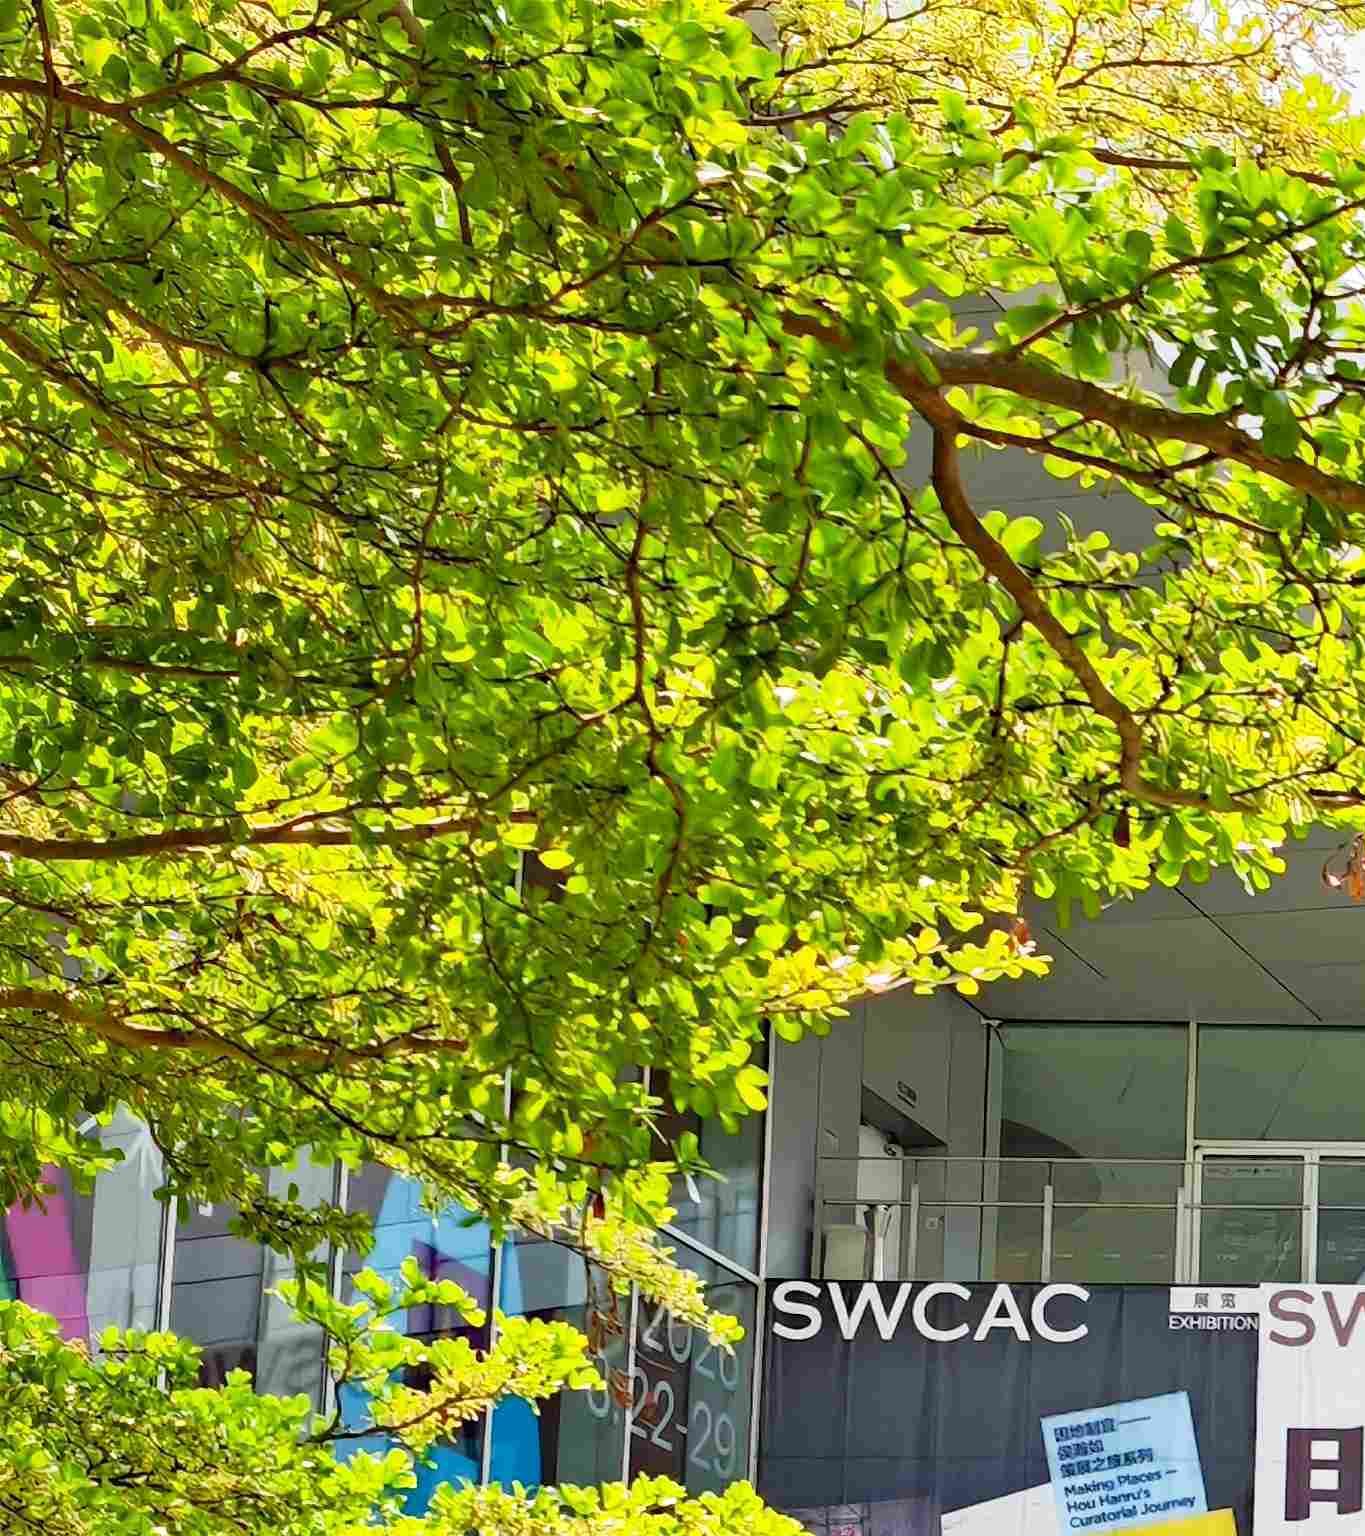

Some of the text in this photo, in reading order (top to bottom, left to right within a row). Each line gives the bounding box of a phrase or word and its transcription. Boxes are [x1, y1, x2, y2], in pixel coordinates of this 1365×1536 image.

[772, 1282, 1090, 1342] SWCAC
[1169, 1315, 1259, 1330] EXHIBITION
[1064, 1479, 1115, 1498] Making
[1066, 1488, 1151, 1513] Hou Hanru's
[1070, 1496, 1196, 1528] Curatorial Journey
